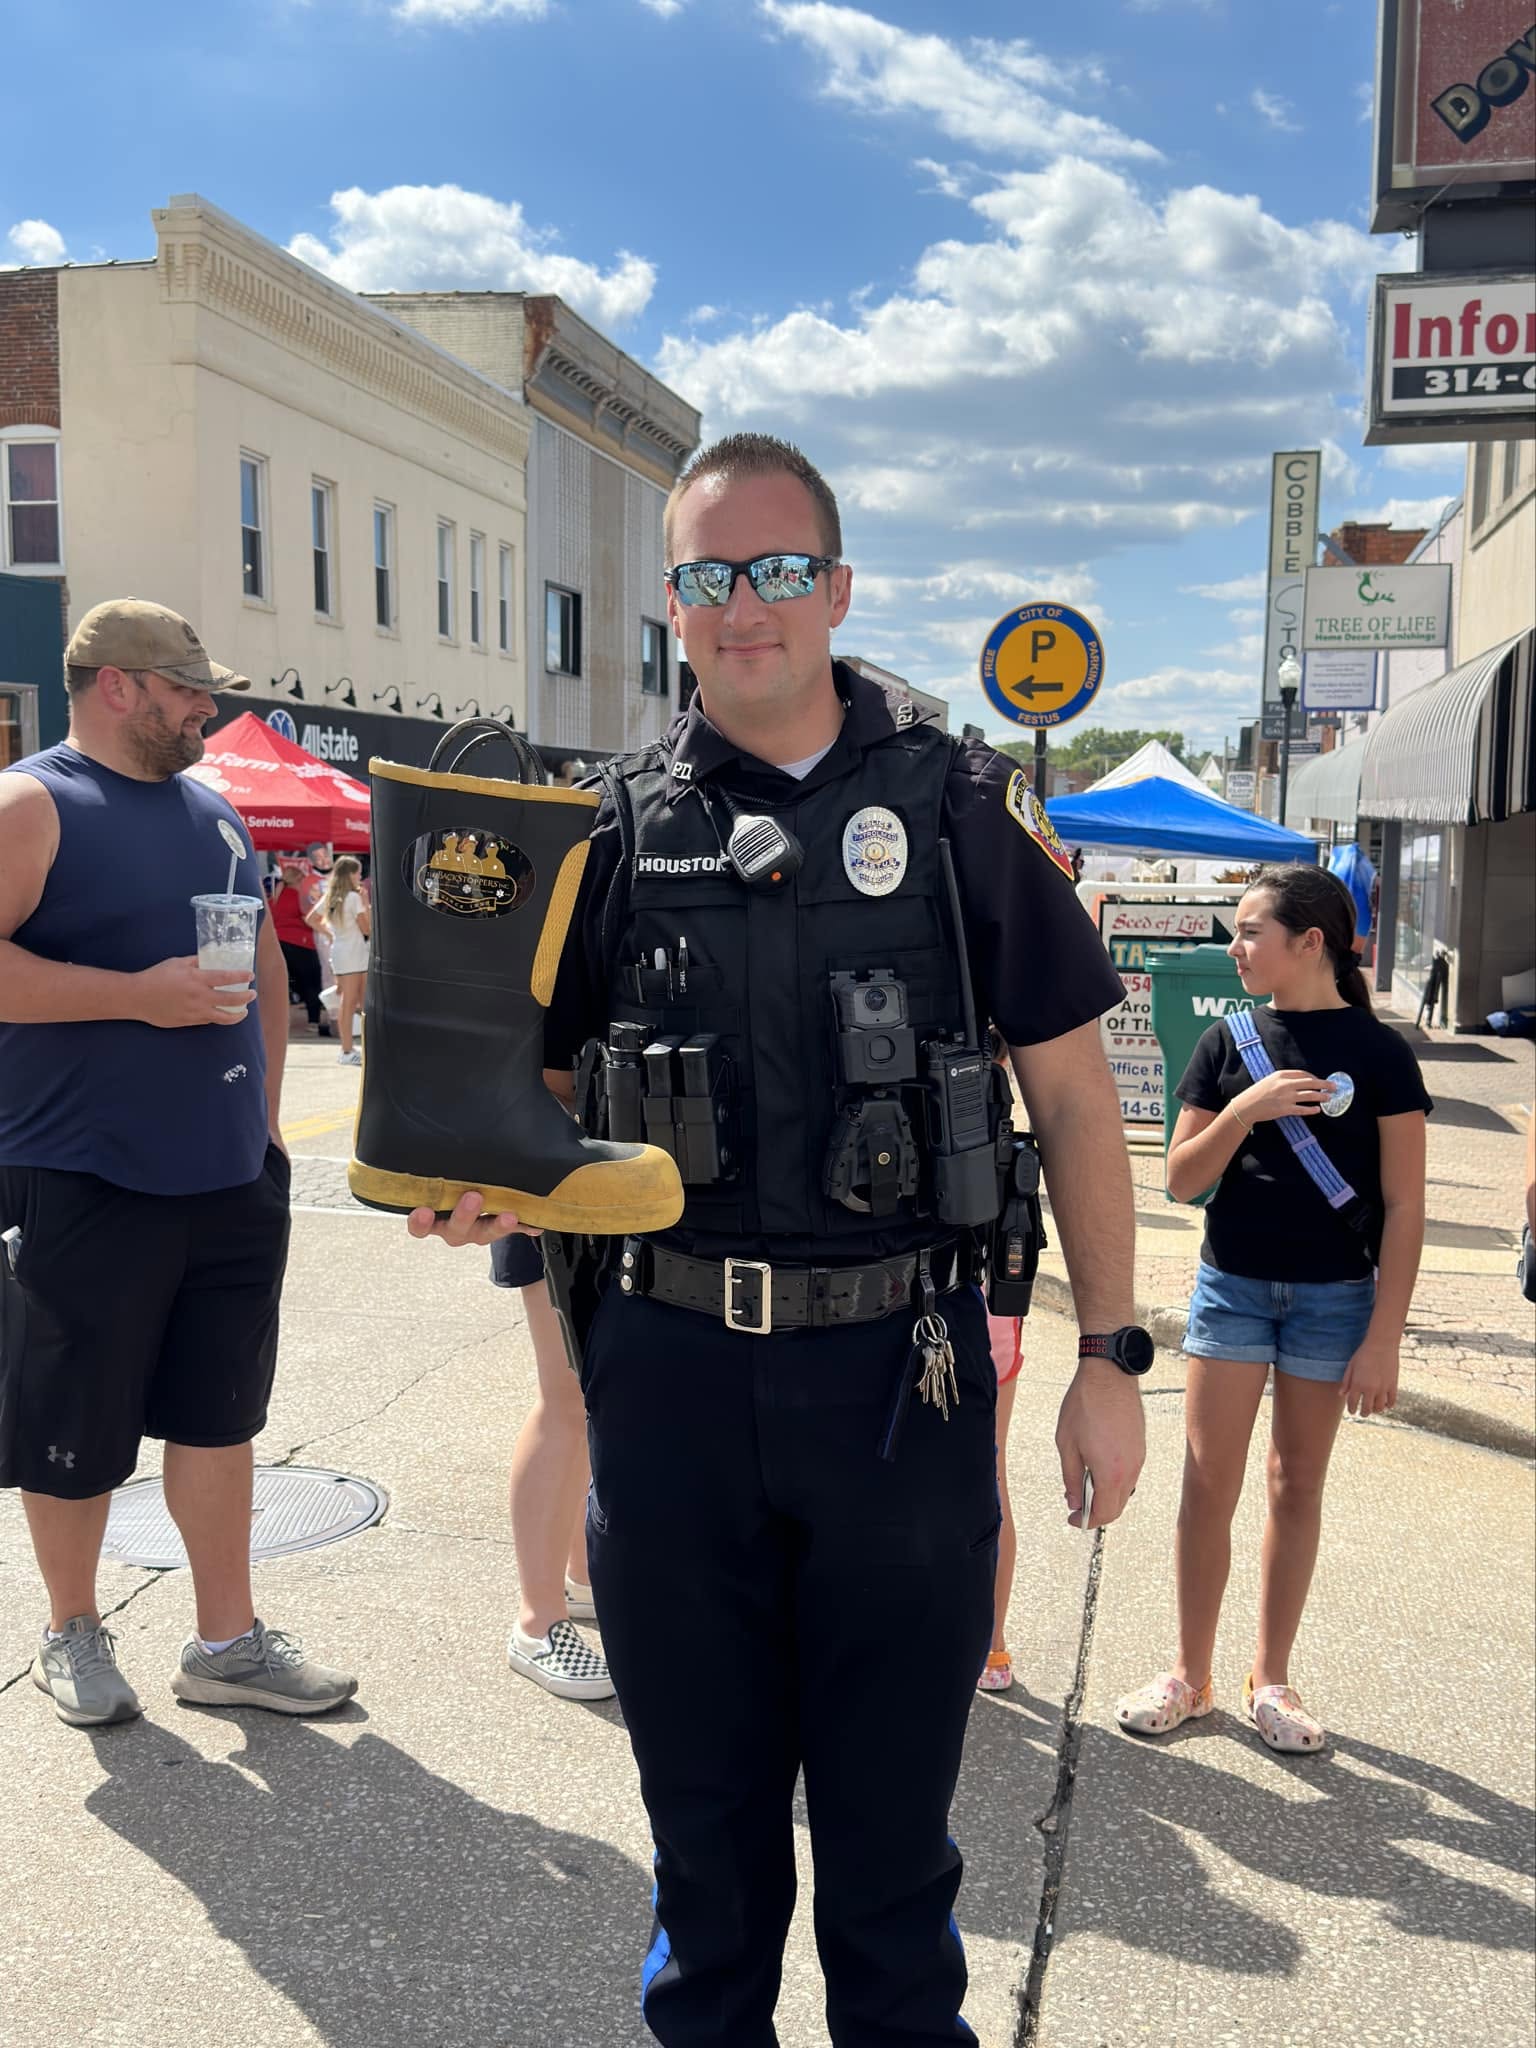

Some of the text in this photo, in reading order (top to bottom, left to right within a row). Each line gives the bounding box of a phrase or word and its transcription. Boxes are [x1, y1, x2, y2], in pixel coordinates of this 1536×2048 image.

[1284, 459, 1308, 574] COBBLE
[1018, 607, 1063, 621] CITY OF
[1315, 616, 1436, 633] TREE OF LIFE
[1315, 632, 1436, 642] Home Decor & Furnishings
[1031, 630, 1056, 663] P
[984, 649, 996, 678] FREE
[1084, 640, 1099, 689] PARKING
[1017, 712, 1060, 725] FESTUS
[301, 724, 359, 762] Allstate
[247, 816, 294, 829] Services
[1112, 913, 1208, 936] Seed of Life
[1107, 1017, 1126, 1031] Of
[1121, 1102, 1165, 1116] 14-6
